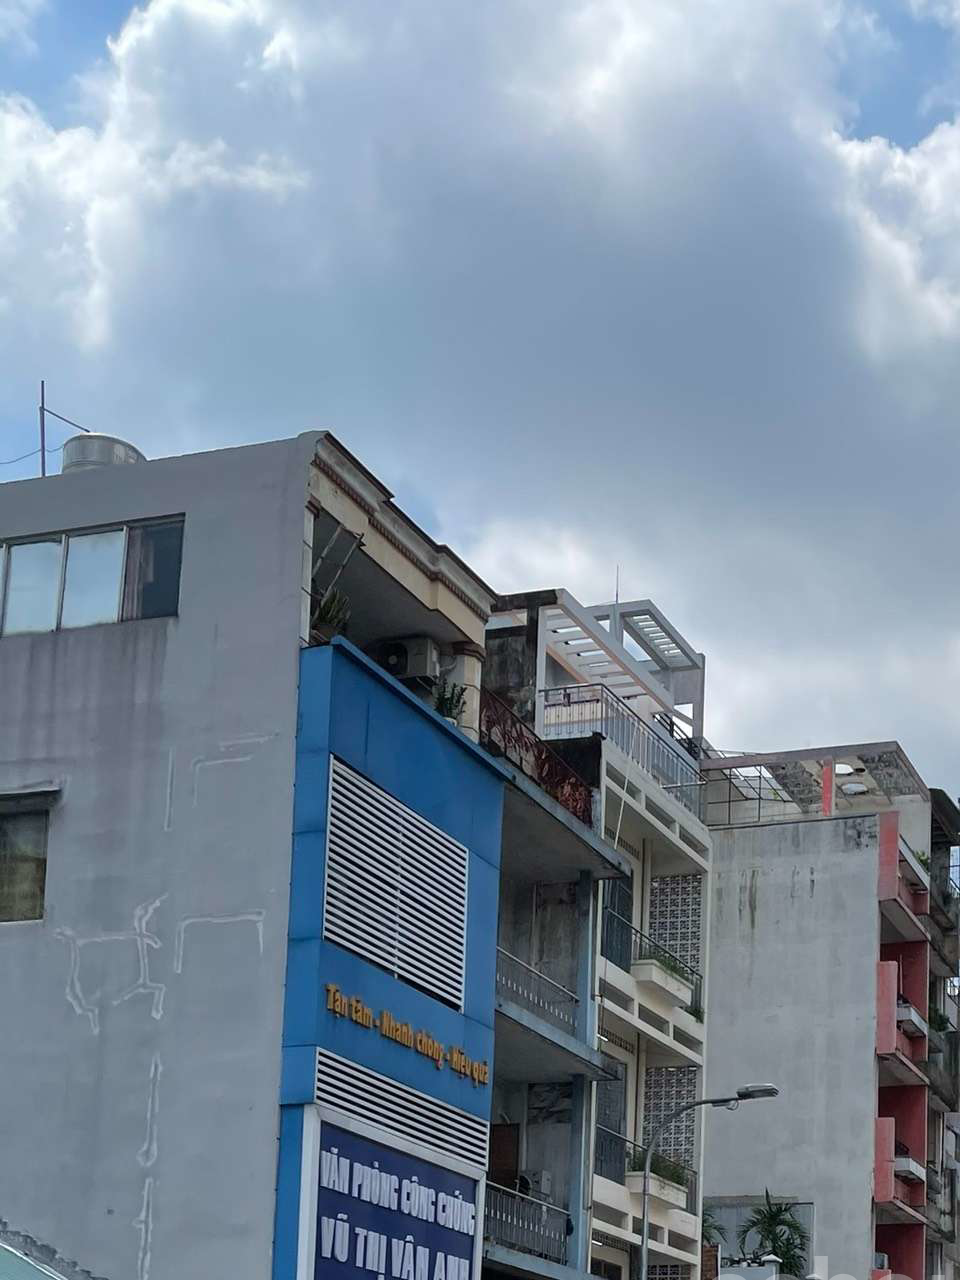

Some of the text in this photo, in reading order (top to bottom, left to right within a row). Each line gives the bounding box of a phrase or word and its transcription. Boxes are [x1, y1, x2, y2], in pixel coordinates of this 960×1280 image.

[381, 1010, 414, 1048] Nhanh
[401, 1176, 436, 1223] CÔNG
[321, 1214, 350, 1263] VŨ
